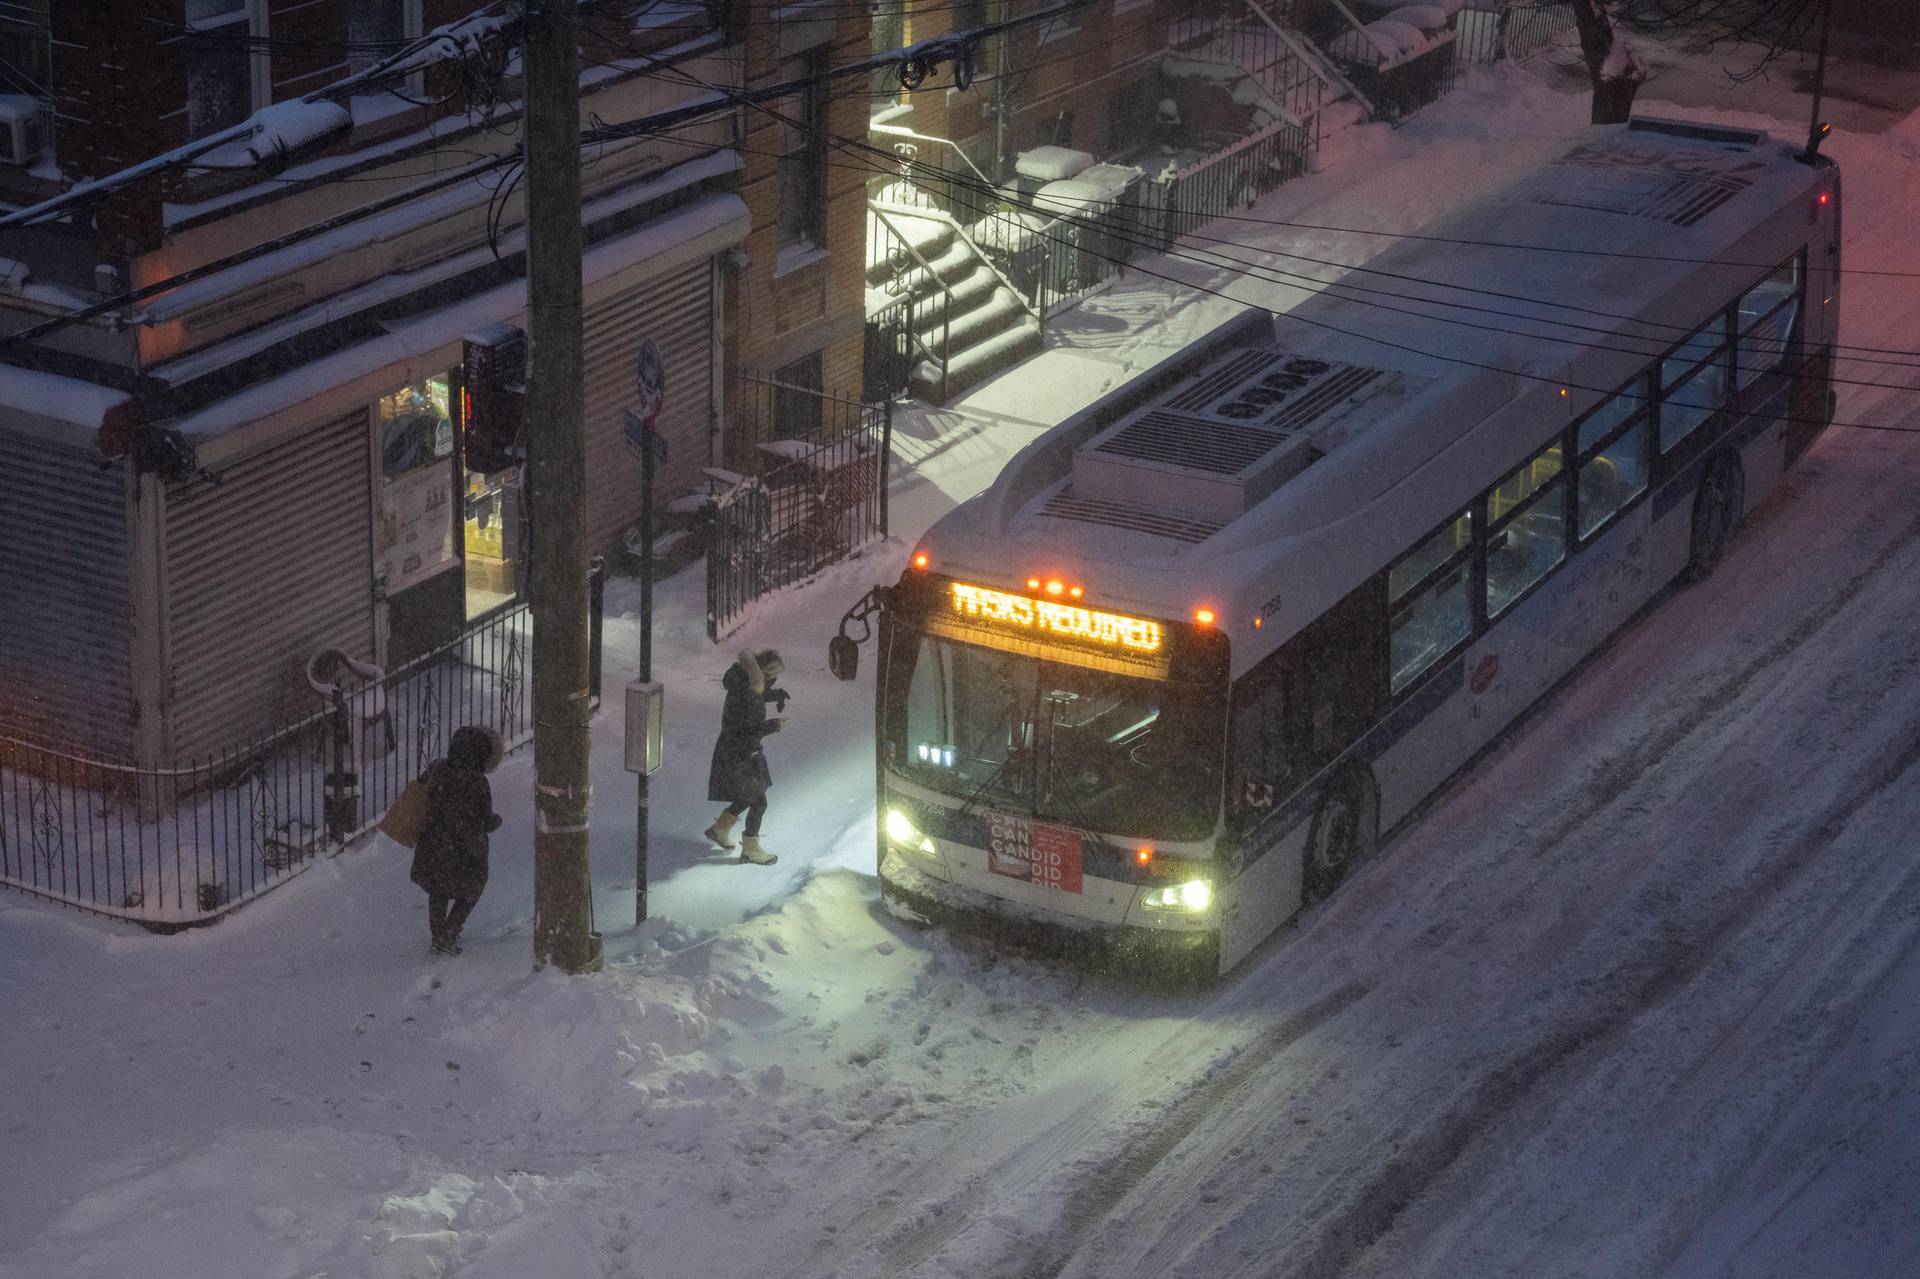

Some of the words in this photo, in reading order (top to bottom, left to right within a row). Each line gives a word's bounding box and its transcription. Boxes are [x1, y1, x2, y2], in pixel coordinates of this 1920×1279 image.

[1260, 594, 1281, 620] 7268
[991, 825, 1029, 844] CAN
[992, 840, 1061, 866] CANDID
[1032, 863, 1061, 881] DID
